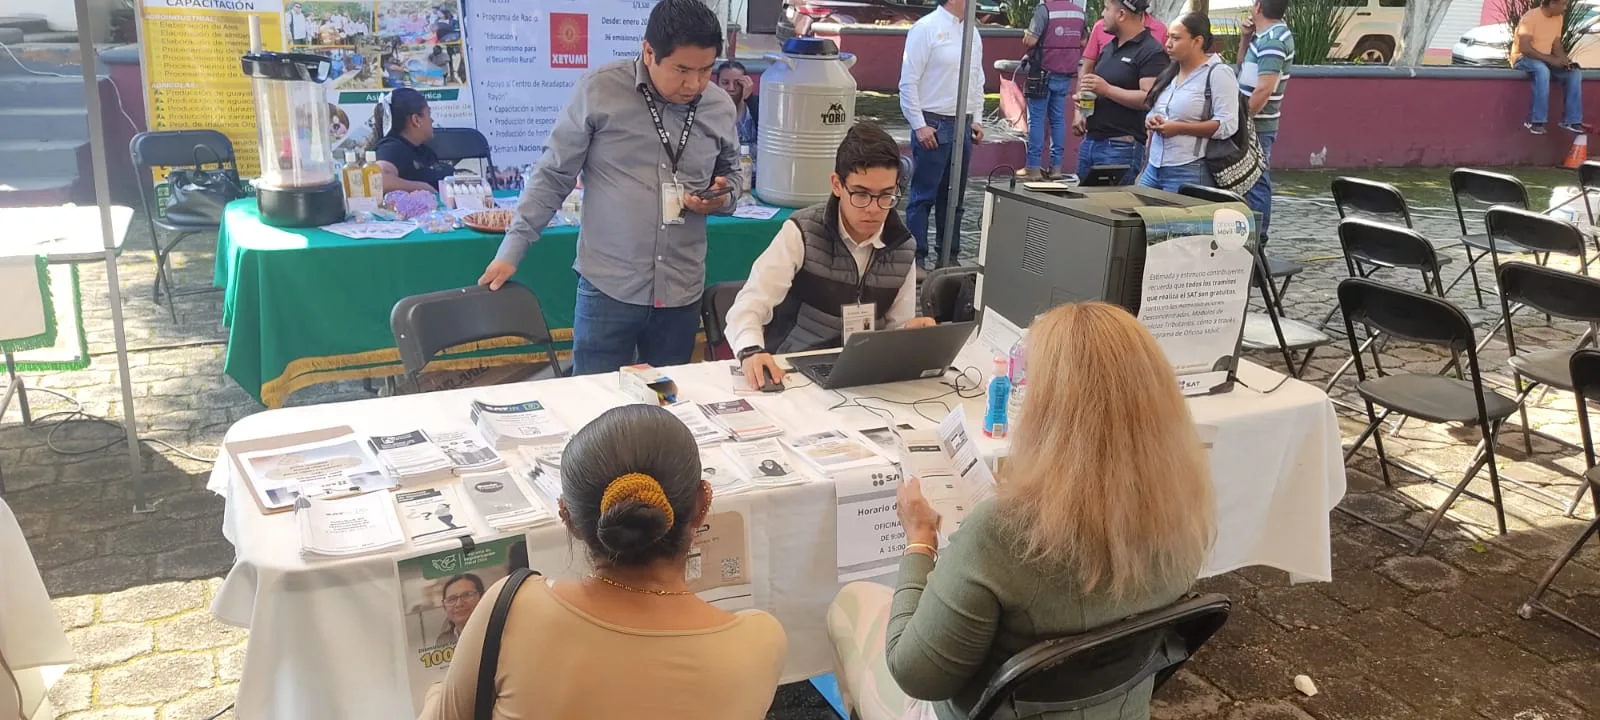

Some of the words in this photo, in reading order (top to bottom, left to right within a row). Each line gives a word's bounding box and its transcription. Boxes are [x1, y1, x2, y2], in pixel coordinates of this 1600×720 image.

[482, 13, 510, 22] Programa
[601, 16, 621, 24] Desde:
[552, 54, 587, 65] XETUMI
[512, 80, 532, 88] Centro
[821, 112, 846, 124] TORO
[658, 128, 668, 143] SAT
[1158, 293, 1179, 301] realiza
[858, 504, 890, 517] Horario
[874, 521, 902, 531] OFICINA
[888, 543, 906, 553] 15:00
